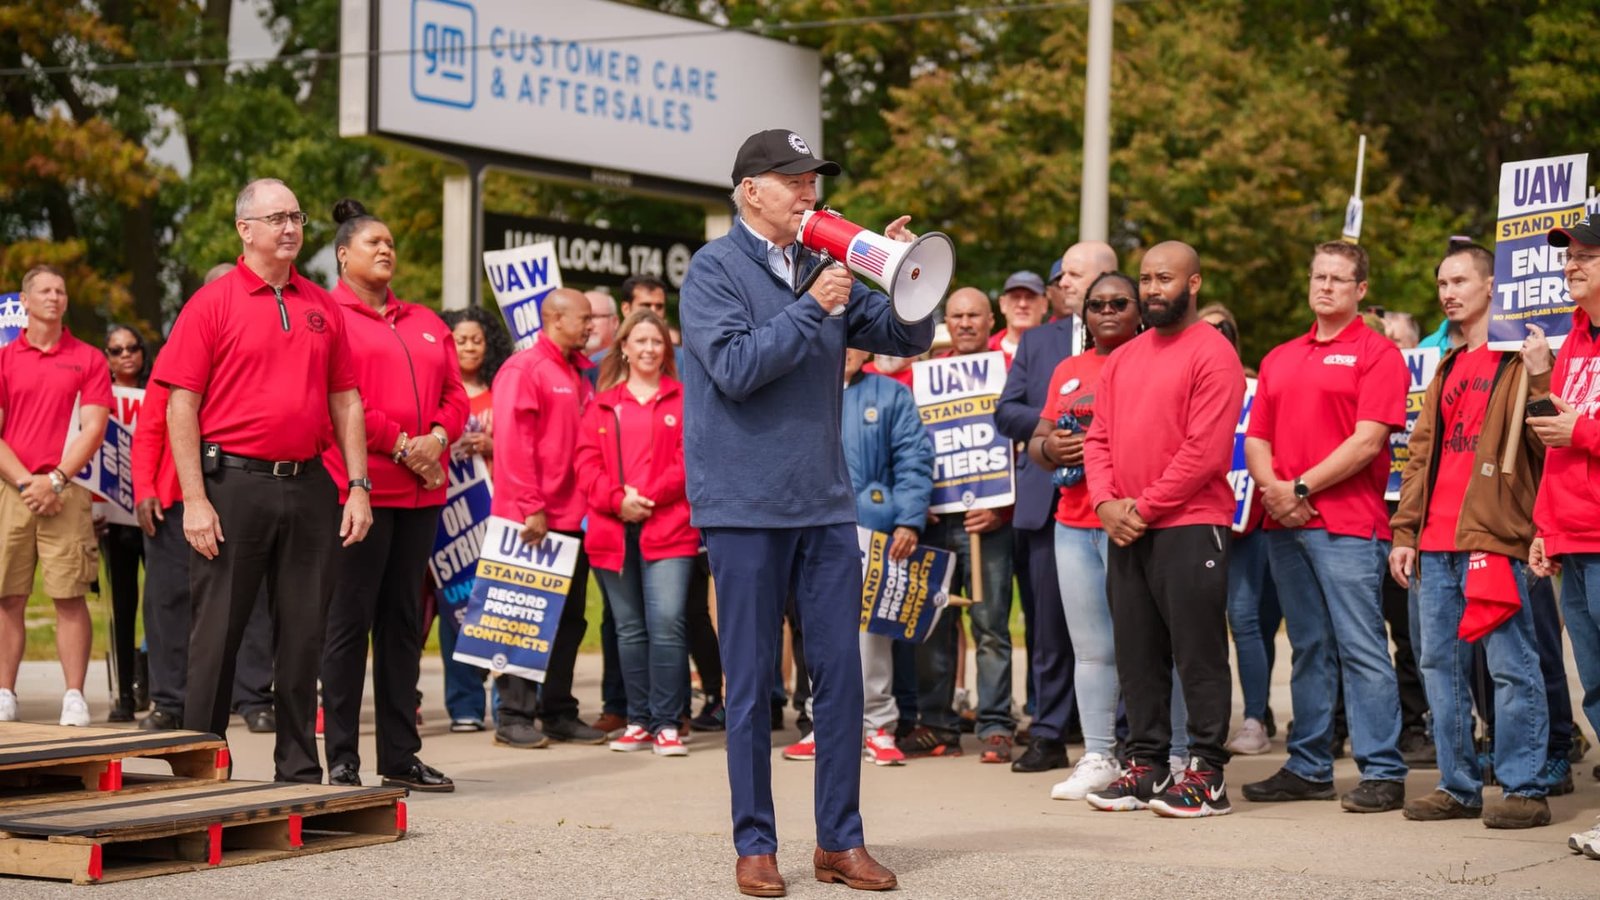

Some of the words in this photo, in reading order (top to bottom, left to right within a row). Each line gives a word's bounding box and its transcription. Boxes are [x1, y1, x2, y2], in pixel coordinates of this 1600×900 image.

[490, 26, 642, 86] CUSTOMER
[652, 60, 719, 101] CARE
[490, 68, 507, 99] &
[517, 71, 694, 133] AFTERSALES
[1513, 162, 1573, 207] UAW
[1502, 216, 1554, 237] STAND
[1560, 211, 1581, 228] UP
[488, 256, 549, 294] UAW
[558, 233, 629, 276] LOCAL
[628, 244, 664, 279] 174
[1511, 244, 1569, 278] END
[512, 300, 541, 337] ON
[929, 359, 989, 396] UAW
[921, 402, 974, 422] STAND
[934, 422, 995, 454] END
[103, 439, 118, 477] ON
[116, 427, 134, 511] STRIKE
[932, 446, 1008, 480] TIERS
[442, 496, 473, 538] ON
[433, 517, 488, 582] STRIK
[500, 526, 563, 568] UAW
[483, 565, 537, 585] STAND
[541, 578, 564, 590] UP
[860, 568, 880, 624] STAND
[872, 539, 883, 562] UP
[899, 561, 920, 623] RECORD
[904, 550, 936, 639] CONTRACTS
[484, 600, 544, 623] PROFITS
[487, 586, 547, 609] RECORD
[463, 625, 549, 653] CONTRACTS
[480, 615, 540, 638] RECORD
